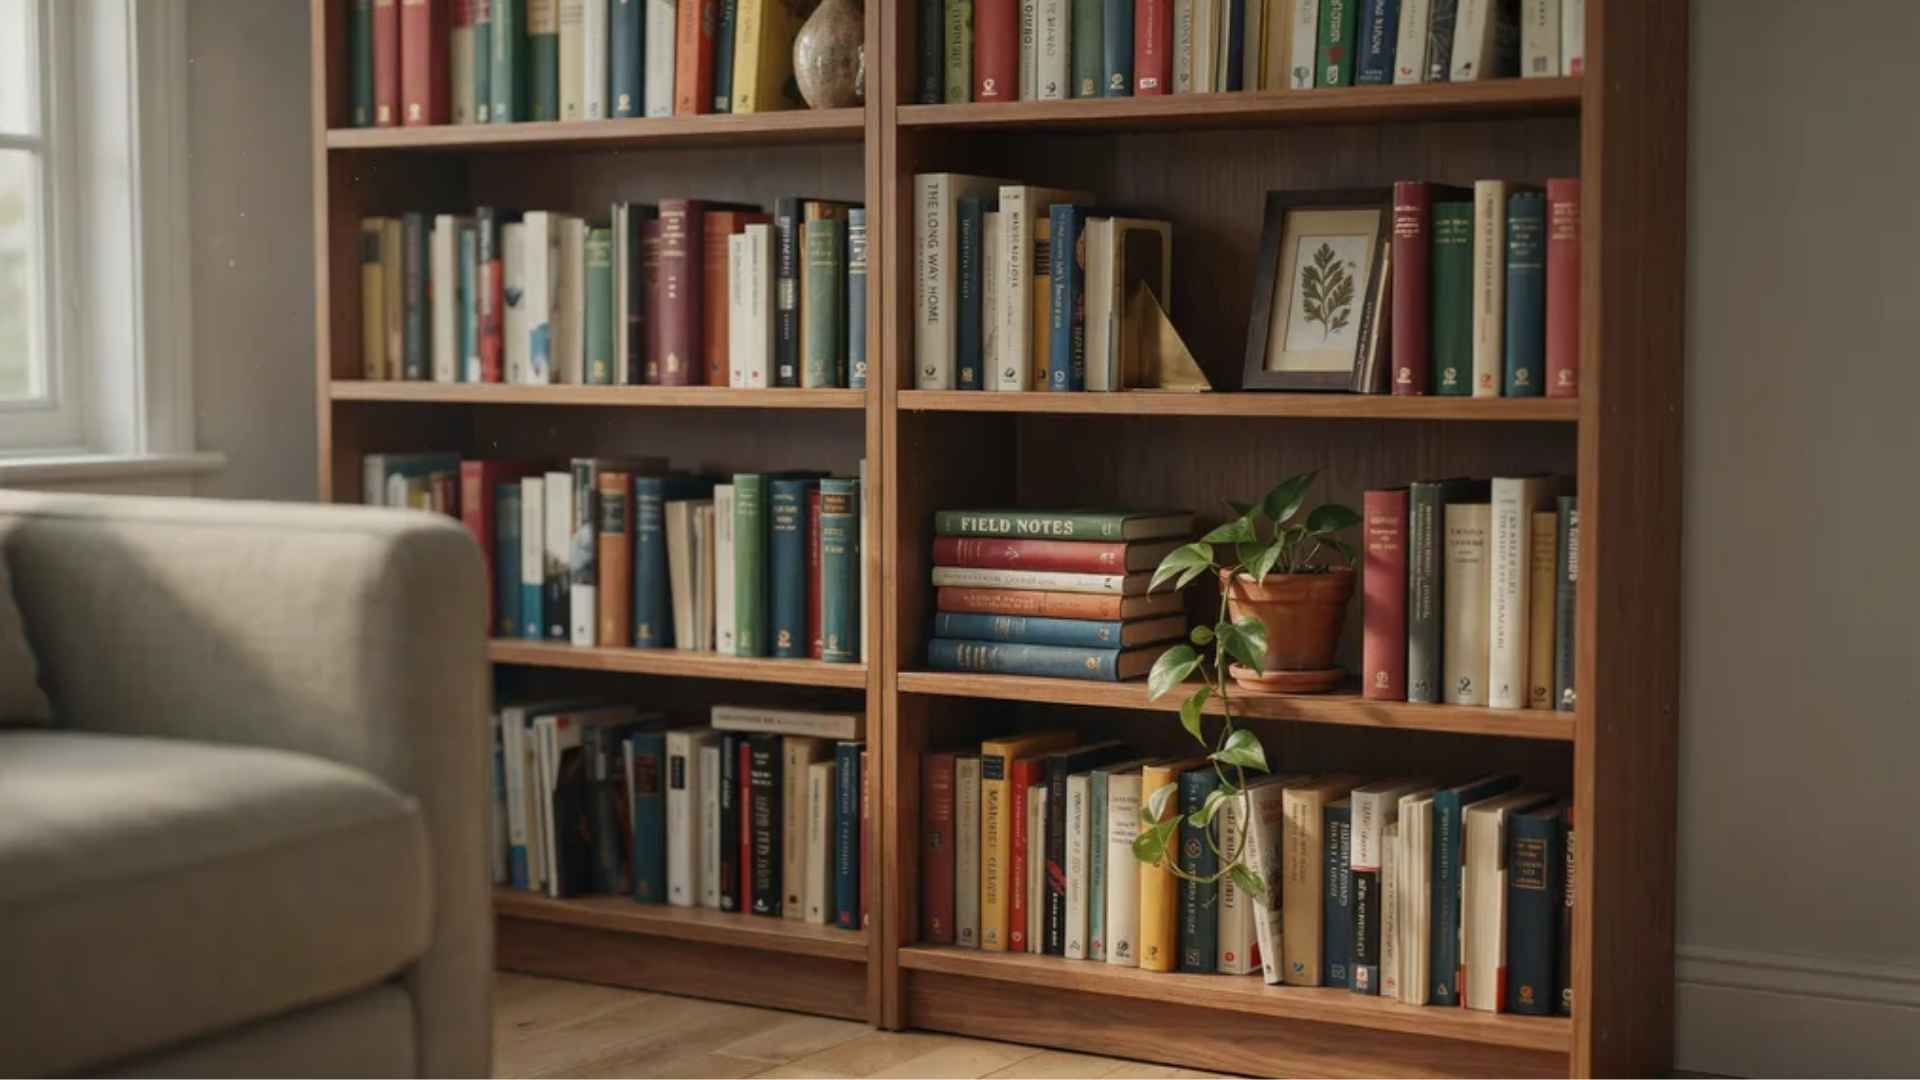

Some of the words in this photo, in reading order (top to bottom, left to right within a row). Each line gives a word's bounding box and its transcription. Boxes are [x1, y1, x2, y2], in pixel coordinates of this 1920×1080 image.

[928, 183, 939, 209] THE
[928, 211, 939, 249] LONG
[927, 253, 939, 283] WAY
[927, 286, 939, 325] HOME
[960, 517, 1010, 533] FIELD
[1016, 519, 1074, 535] NOTES
